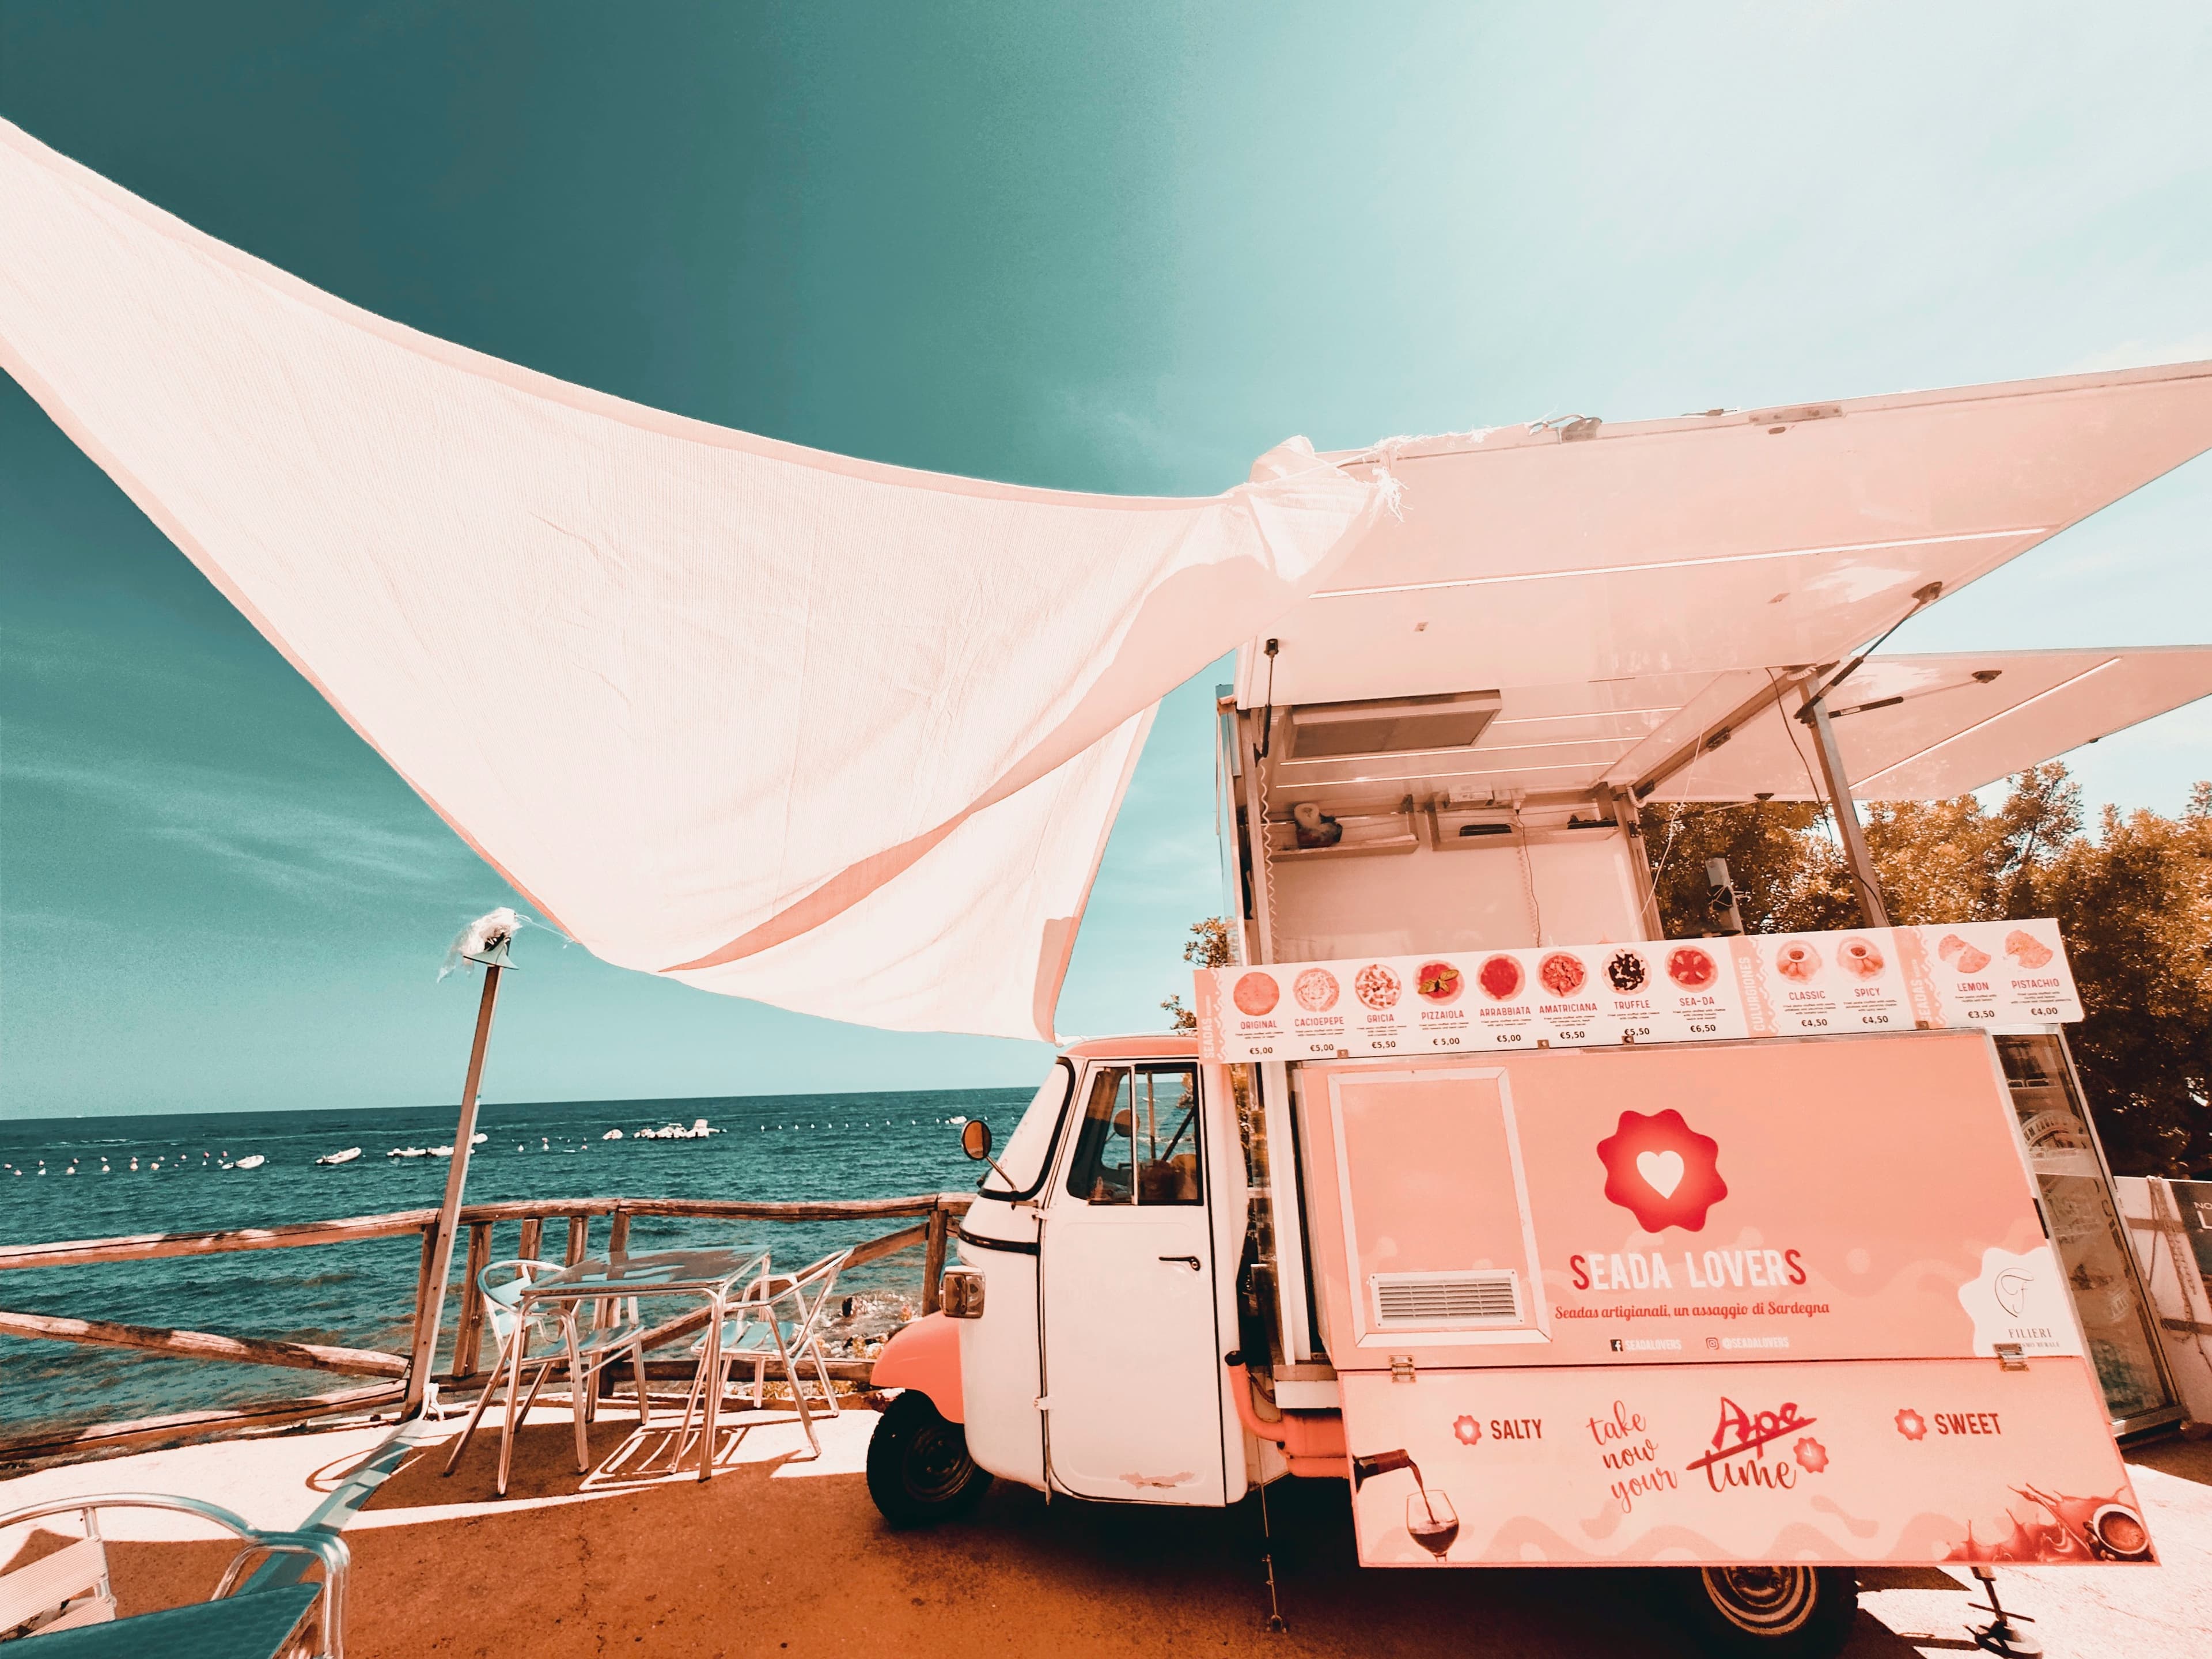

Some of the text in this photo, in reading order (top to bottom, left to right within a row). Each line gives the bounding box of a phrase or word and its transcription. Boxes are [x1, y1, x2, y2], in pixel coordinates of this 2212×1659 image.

[1957, 983, 1988, 991] LEMON
[2012, 979, 2059, 988] PISTACHIO
[1738, 956, 1766, 1031] CULURGIONES
[1789, 991, 1825, 1000] CLASSIC
[1854, 988, 1880, 997] SPICY
[1614, 1000, 1650, 1009] TRUFFLE
[1680, 997, 1714, 1006] SEA-DA
[1480, 1007, 1531, 1016] ARRABBIATA
[1540, 1003, 1597, 1013] AMATRICIANA
[2031, 1007, 2058, 1016] €4,00
[1367, 1014, 1394, 1022] GRICIA
[1422, 1010, 1464, 1020] PIZZAIOLA
[1241, 1021, 1277, 1029] ORIGINAL
[1295, 1017, 1344, 1027] CACIOEPEPE
[1624, 1028, 1649, 1036] €5,50
[1201, 1018, 1215, 1059] SEADAS
[1570, 1248, 1806, 1290] SEADA LOVERS
[1555, 1302, 1830, 1321] Seadas artigianali, un assaggio di Sardegna
[2009, 1328, 2051, 1338] FILIERI
[1624, 1339, 1681, 1351] SEADALOVERS
[1722, 1336, 1789, 1350] @SEADALOVERS
[1586, 1400, 1646, 1445] take
[1934, 1413, 2001, 1434] SWEET
[1491, 1419, 1541, 1440] SALTY
[1711, 1396, 1805, 1460] Ape
[1602, 1438, 1657, 1469] now
[1686, 1443, 1796, 1493] time
[1611, 1467, 1677, 1513] your
